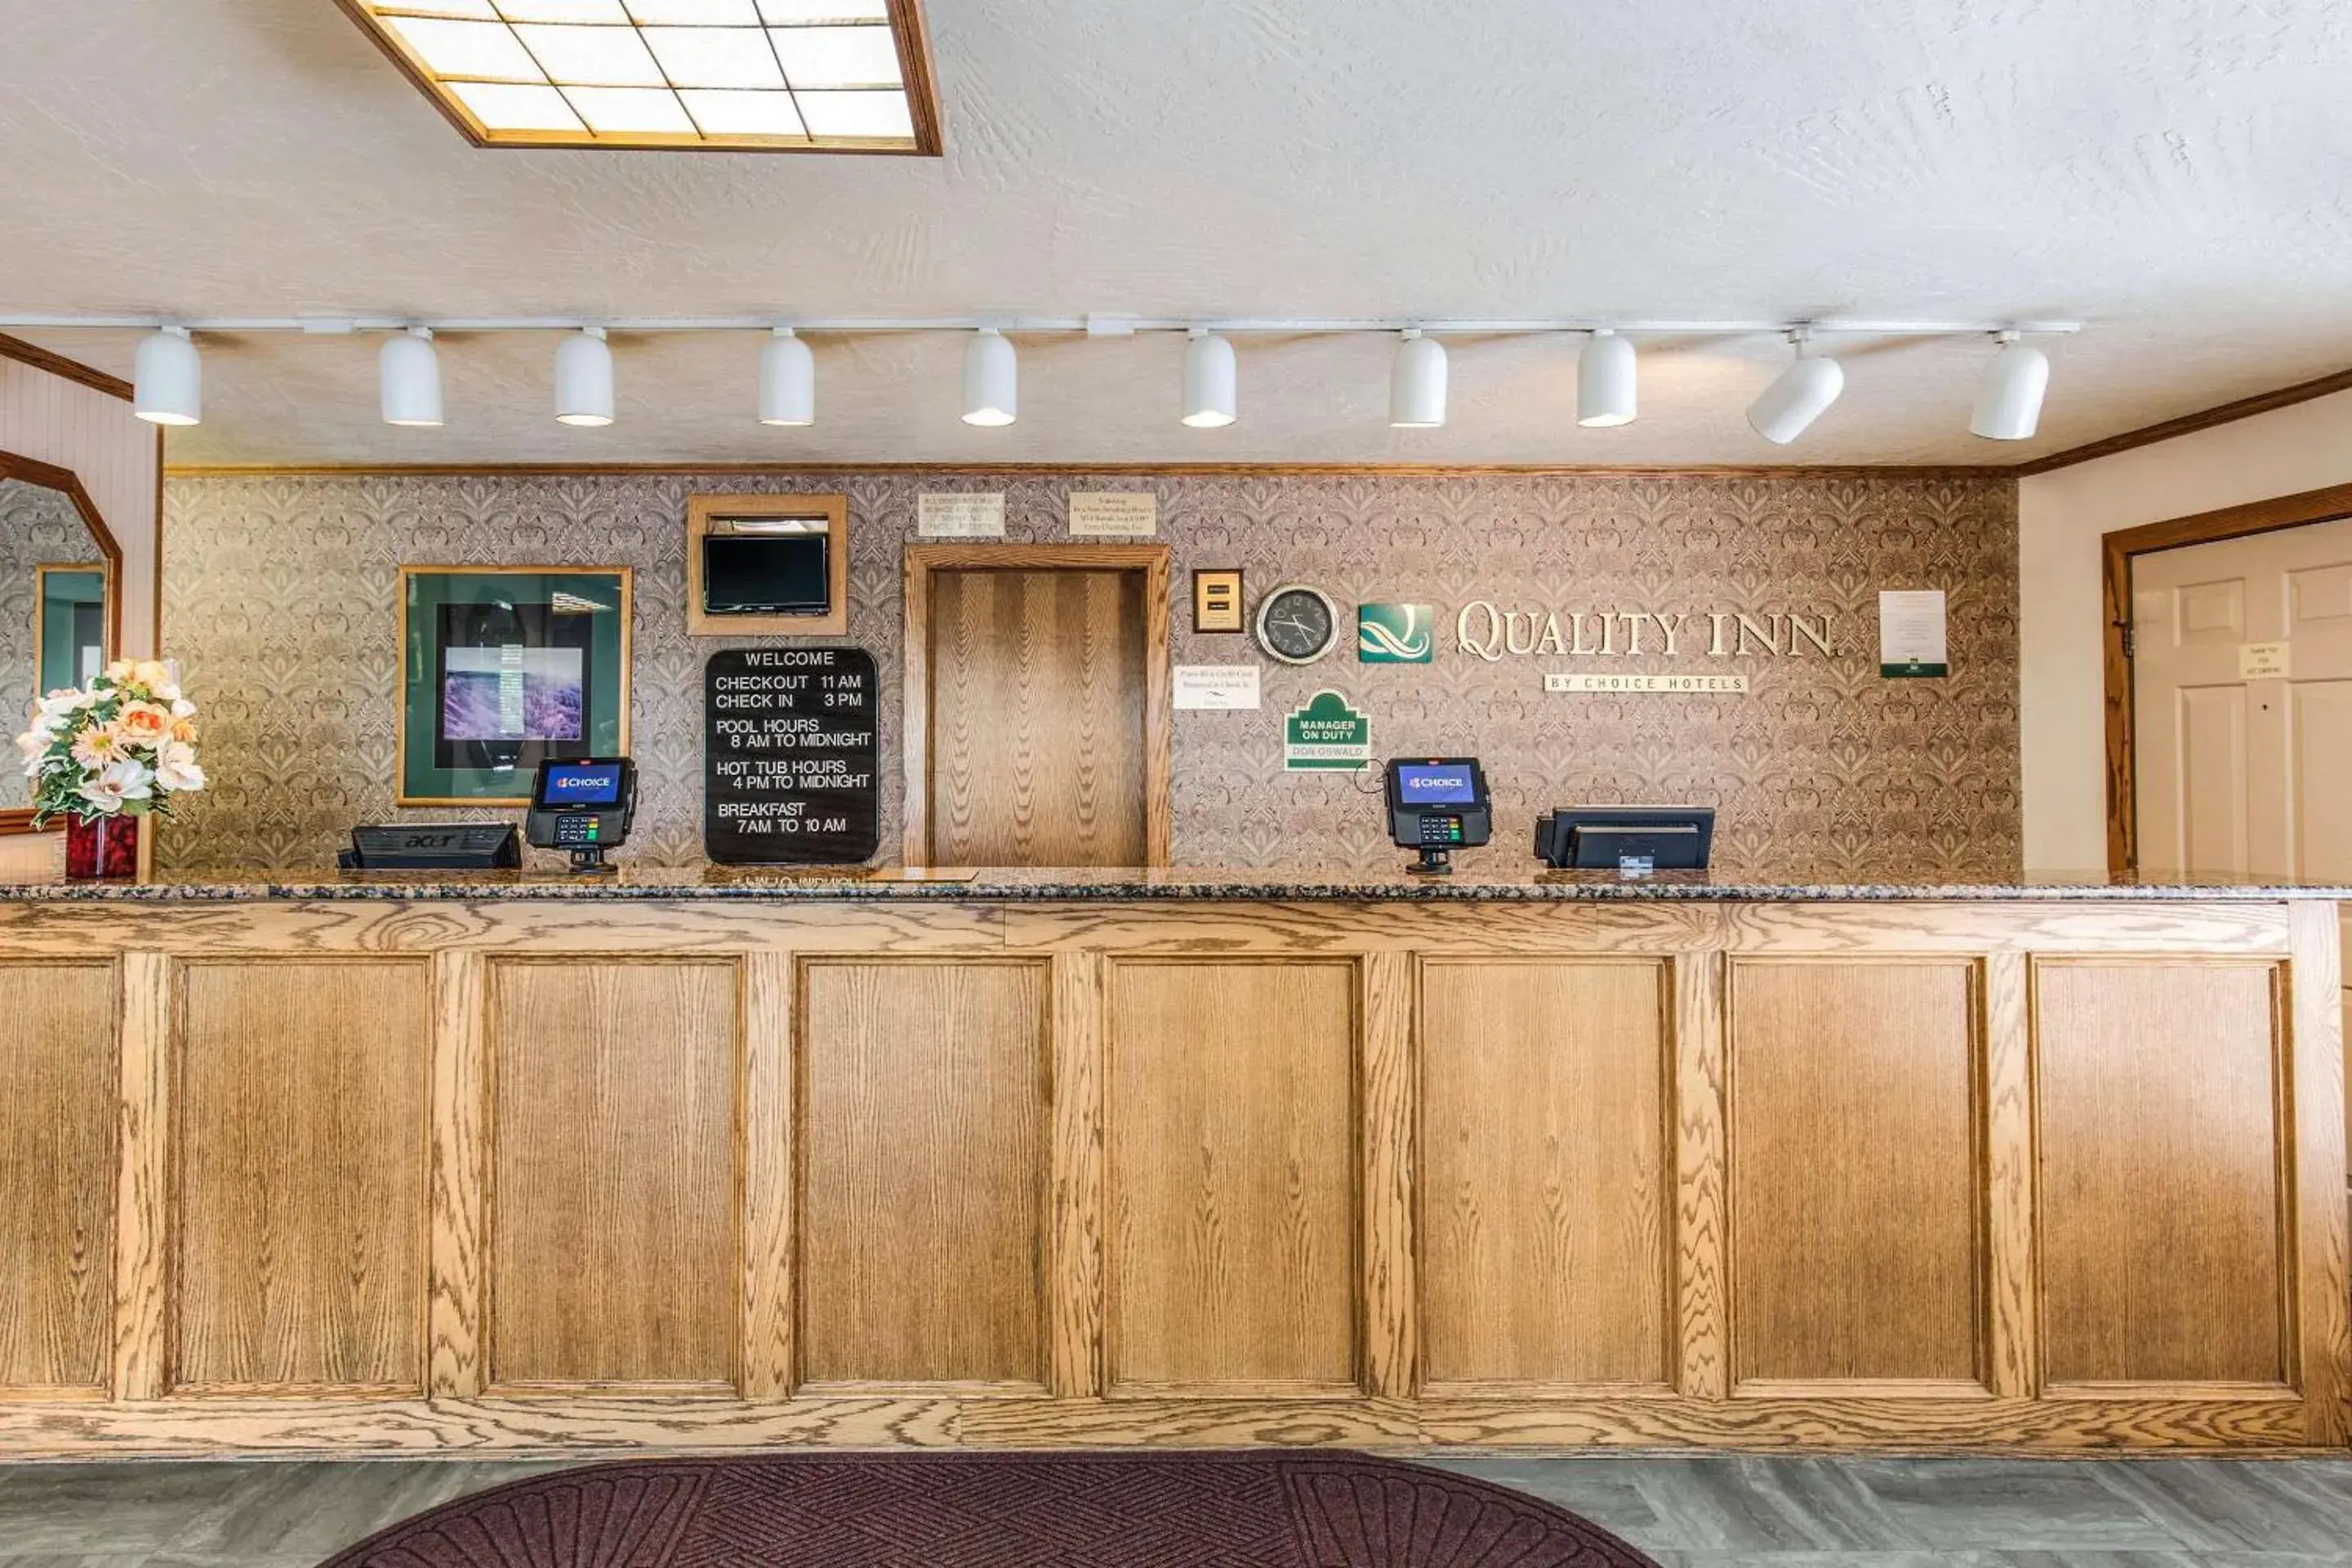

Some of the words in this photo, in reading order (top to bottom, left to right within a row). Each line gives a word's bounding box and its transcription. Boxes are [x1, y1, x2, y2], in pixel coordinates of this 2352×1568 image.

[746, 653, 835, 666] WELCOME
[715, 675, 808, 690] CHECKOUT
[821, 675, 834, 688] 11
[838, 675, 862, 688] AM
[1551, 679, 1571, 689] BY
[1584, 679, 1655, 689] CHOICE
[1669, 679, 1743, 689] HOTELS
[715, 694, 773, 708] CHECK
[778, 694, 793, 707] IN
[824, 693, 835, 706] 3
[838, 693, 862, 706] PM
[716, 719, 758, 734] POOL
[764, 719, 819, 733] HOURS
[1299, 720, 1356, 730] MANAGER
[731, 735, 741, 748] 8
[746, 734, 769, 748] AM
[775, 734, 795, 747] TO
[800, 733, 871, 747] MIDNIGHT
[1302, 730, 1320, 740] ON
[1322, 730, 1353, 740] DUTY
[716, 761, 750, 775] HOT
[755, 761, 788, 774] TUB
[792, 760, 847, 774] HOURS
[568, 777, 610, 786] CHOICE
[733, 777, 742, 790] 4
[746, 777, 769, 789] PM
[773, 776, 793, 789] TO
[800, 774, 871, 788] MIDNIGHT
[1421, 778, 1463, 786] CHOICE
[718, 803, 807, 817] BREAKFAST
[778, 819, 799, 832] TO
[805, 818, 819, 832] 10
[823, 818, 846, 832] AM
[404, 833, 456, 848] acer
